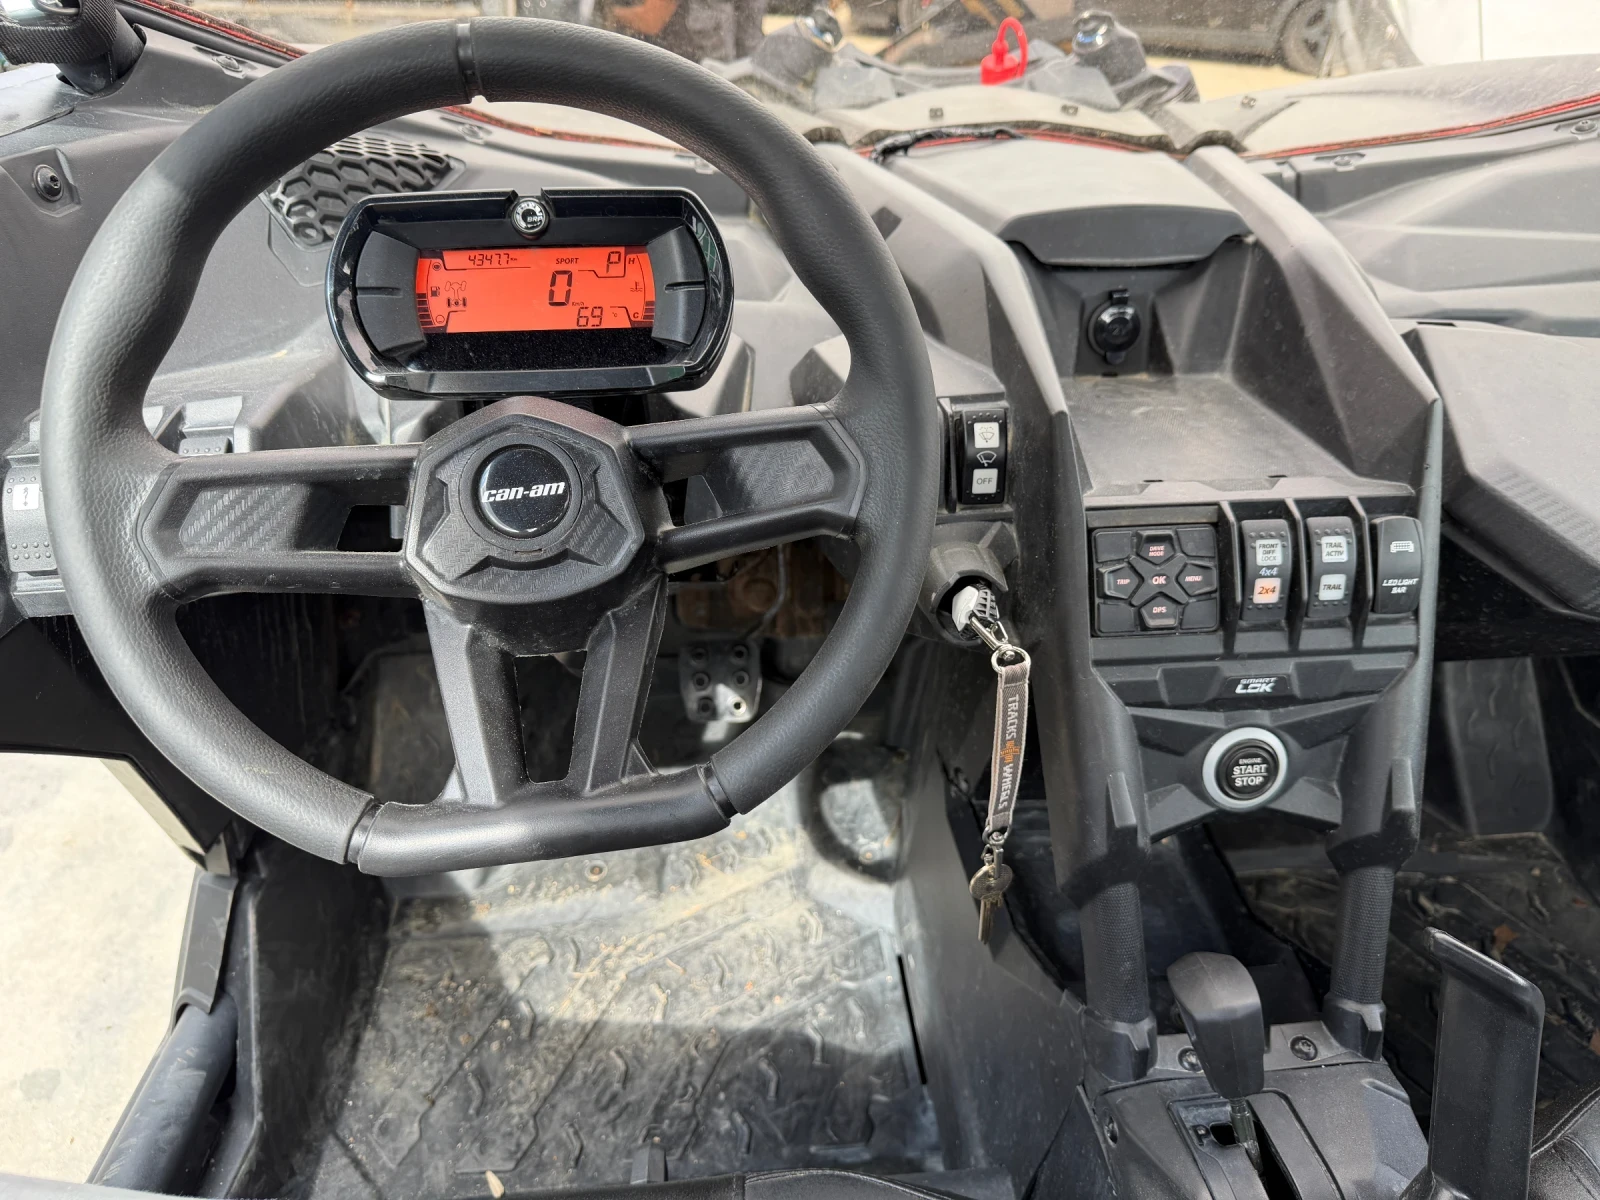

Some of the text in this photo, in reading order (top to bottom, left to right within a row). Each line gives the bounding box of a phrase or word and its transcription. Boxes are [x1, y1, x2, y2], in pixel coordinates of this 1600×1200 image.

[555, 257, 579, 265] SPORT
[548, 270, 573, 307] 0
[576, 306, 604, 328] 69
[976, 477, 993, 485] OFF
[482, 481, 566, 503] can-am
[1259, 567, 1279, 576] 4x4
[1152, 575, 1167, 585] OK
[1184, 575, 1203, 583] MENU
[1257, 586, 1277, 595] 2x4
[1391, 586, 1407, 594] BAR
[999, 694, 1019, 809] TRACKS WHEELS
[1232, 764, 1268, 775] START
[1234, 776, 1264, 787] STOP
